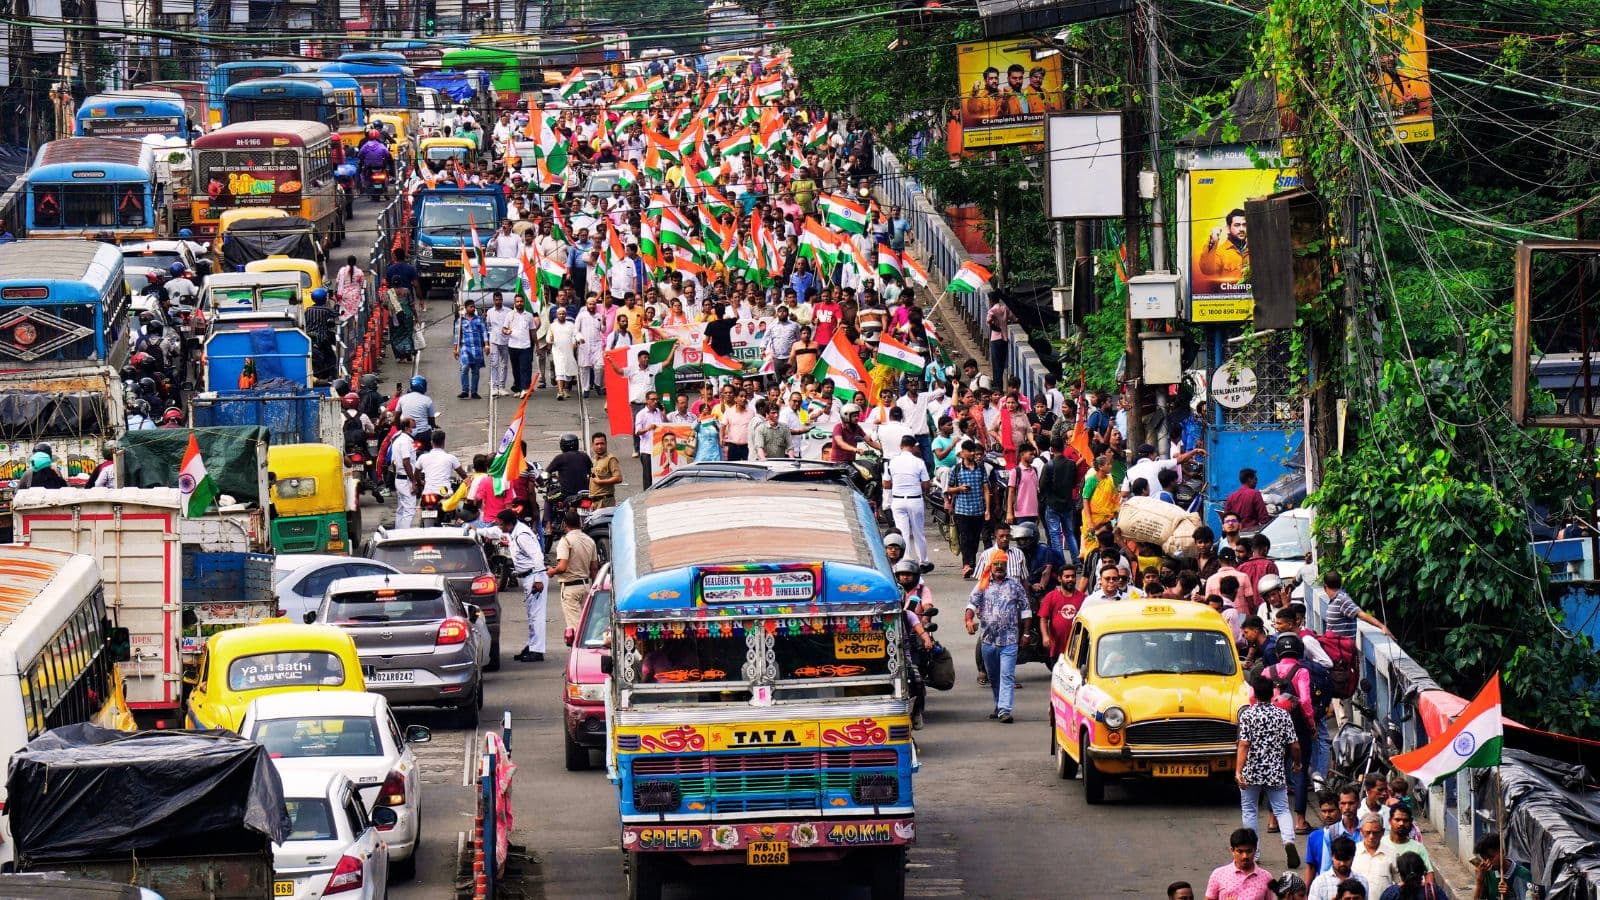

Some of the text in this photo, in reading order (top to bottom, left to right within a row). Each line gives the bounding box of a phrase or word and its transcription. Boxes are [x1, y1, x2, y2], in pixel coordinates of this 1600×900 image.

[1413, 130, 1429, 138] ESG
[743, 576, 773, 598] 24B
[277, 662, 312, 672] sathi
[734, 730, 797, 744] TATA
[639, 827, 703, 849] SPEED
[275, 884, 292, 894] 668
